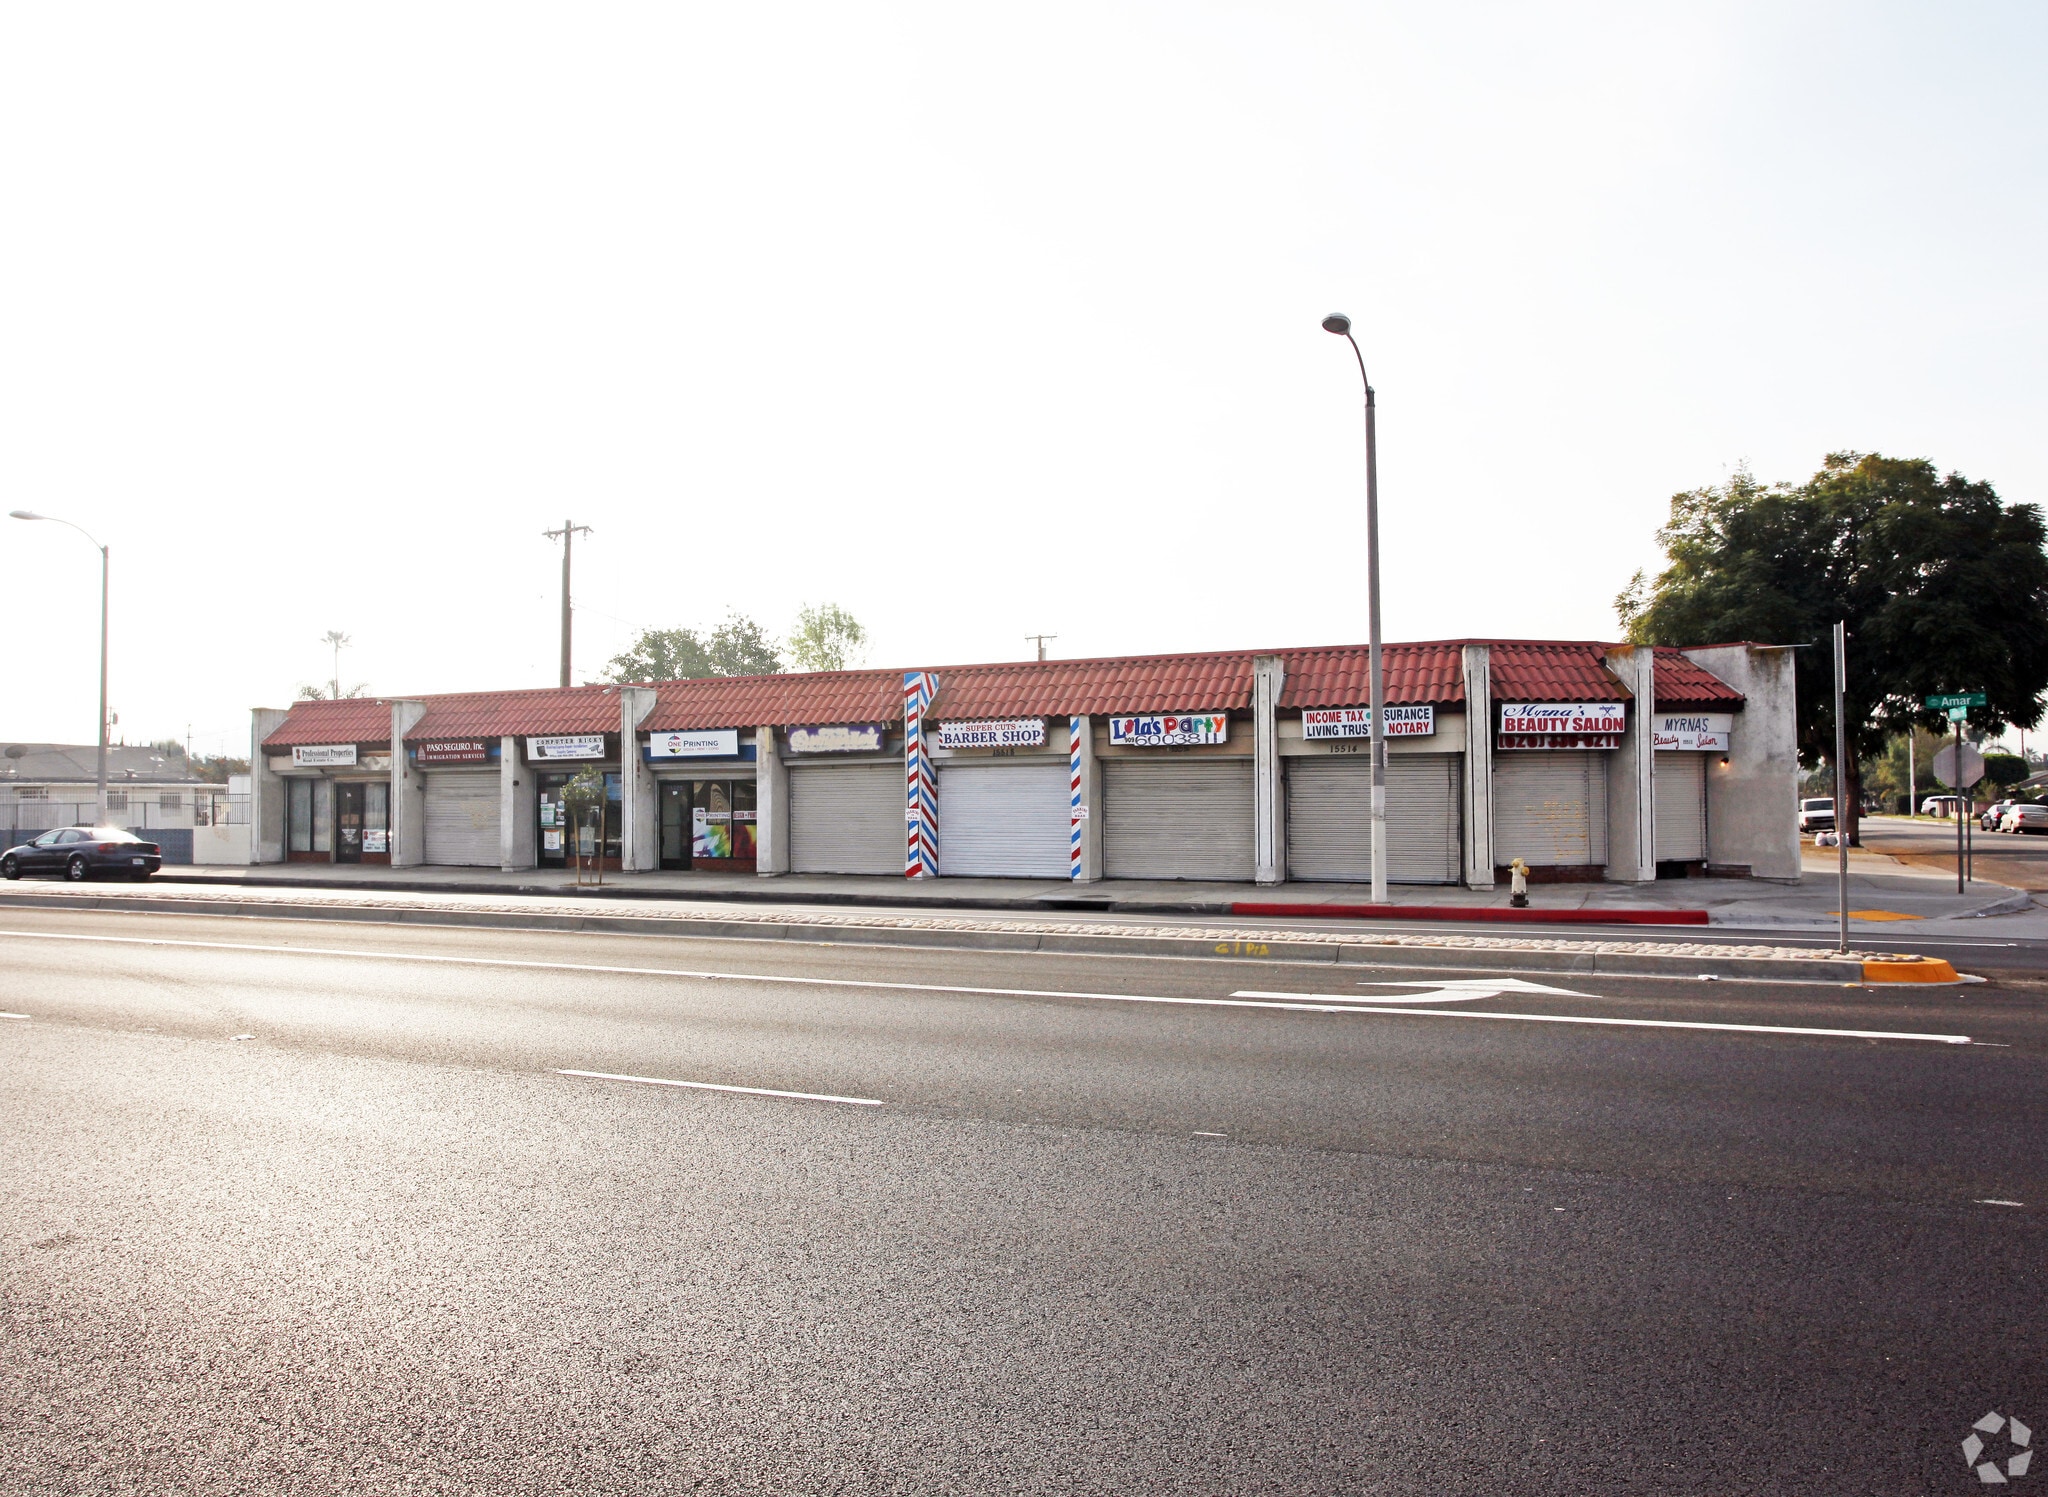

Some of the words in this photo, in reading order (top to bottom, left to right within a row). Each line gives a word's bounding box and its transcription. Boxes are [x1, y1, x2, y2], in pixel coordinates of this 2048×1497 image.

[1941, 697, 1971, 707] Amar
[1306, 712, 1342, 724] INCOME
[1345, 710, 1364, 722] TAX
[1384, 708, 1430, 721] SURANCE
[1503, 704, 1585, 717] Myrna's
[965, 724, 993, 732] SUPER
[995, 723, 1017, 731] CUTS
[1163, 716, 1226, 734] Party
[1307, 725, 1339, 737] LIVING
[1388, 722, 1430, 734] NOTARY
[1504, 717, 1569, 731] BEAUTY
[1572, 717, 1624, 731] SALON
[944, 731, 997, 744] BARBER
[1002, 730, 1041, 742] SHOP
[1653, 733, 1679, 750] Beauty
[1696, 733, 1718, 748] Salon
[302, 748, 330, 758] Professional
[330, 748, 354, 758] Properties
[426, 743, 443, 752] PASO
[473, 742, 485, 750] Inc.
